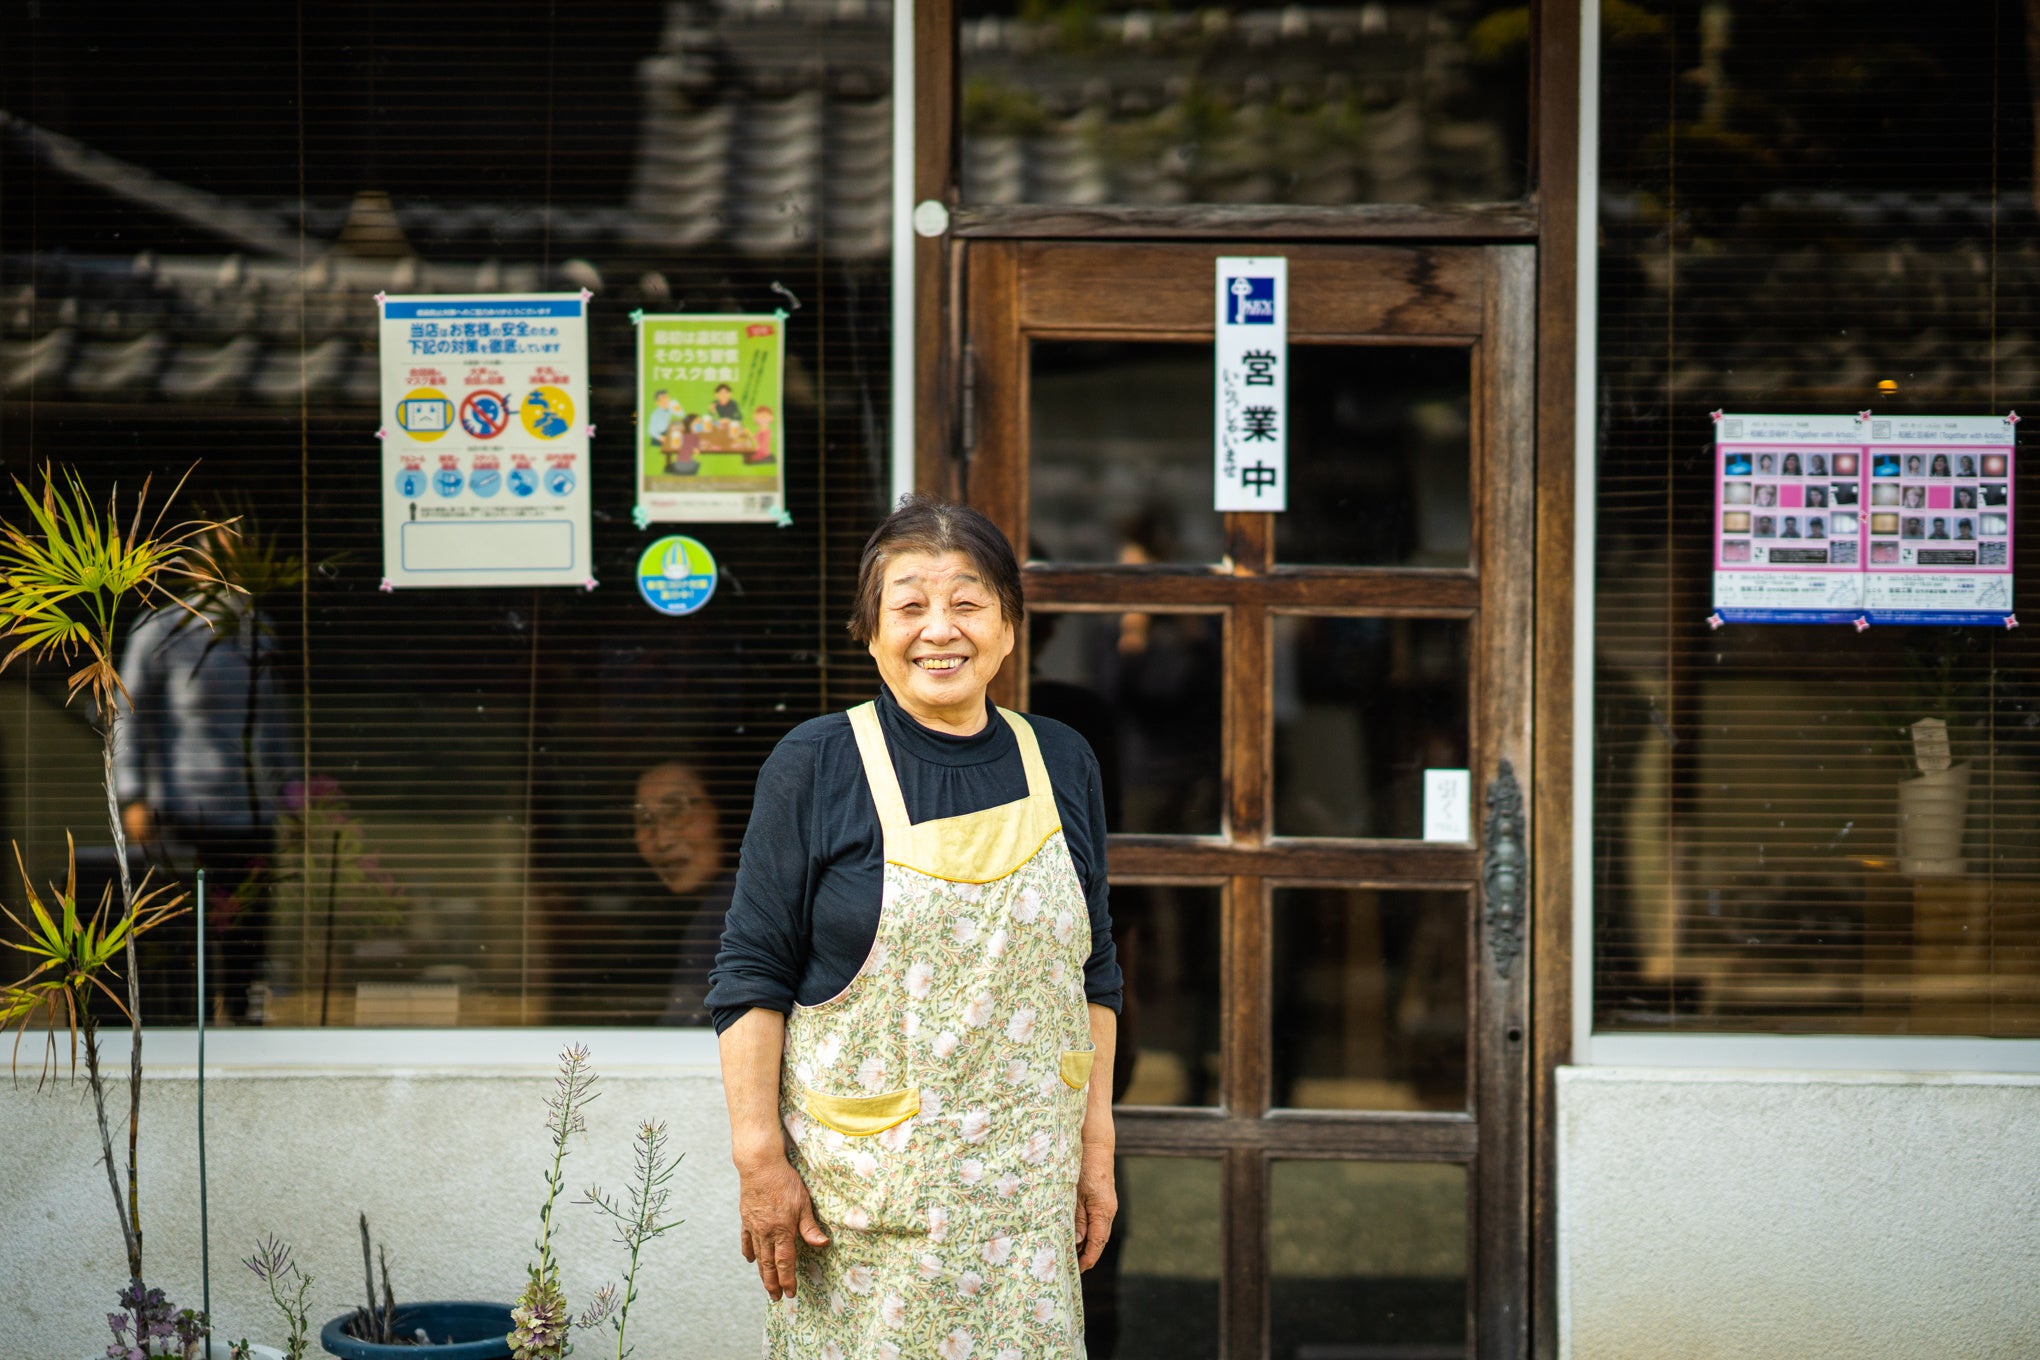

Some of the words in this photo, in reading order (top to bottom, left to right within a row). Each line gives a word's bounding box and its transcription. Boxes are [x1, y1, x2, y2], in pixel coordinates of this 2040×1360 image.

[410, 322, 558, 338] 当店はお客様の安全のため
[408, 339, 561, 355] 下記の対策を徹底しています
[1242, 349, 1277, 497] 営業中
